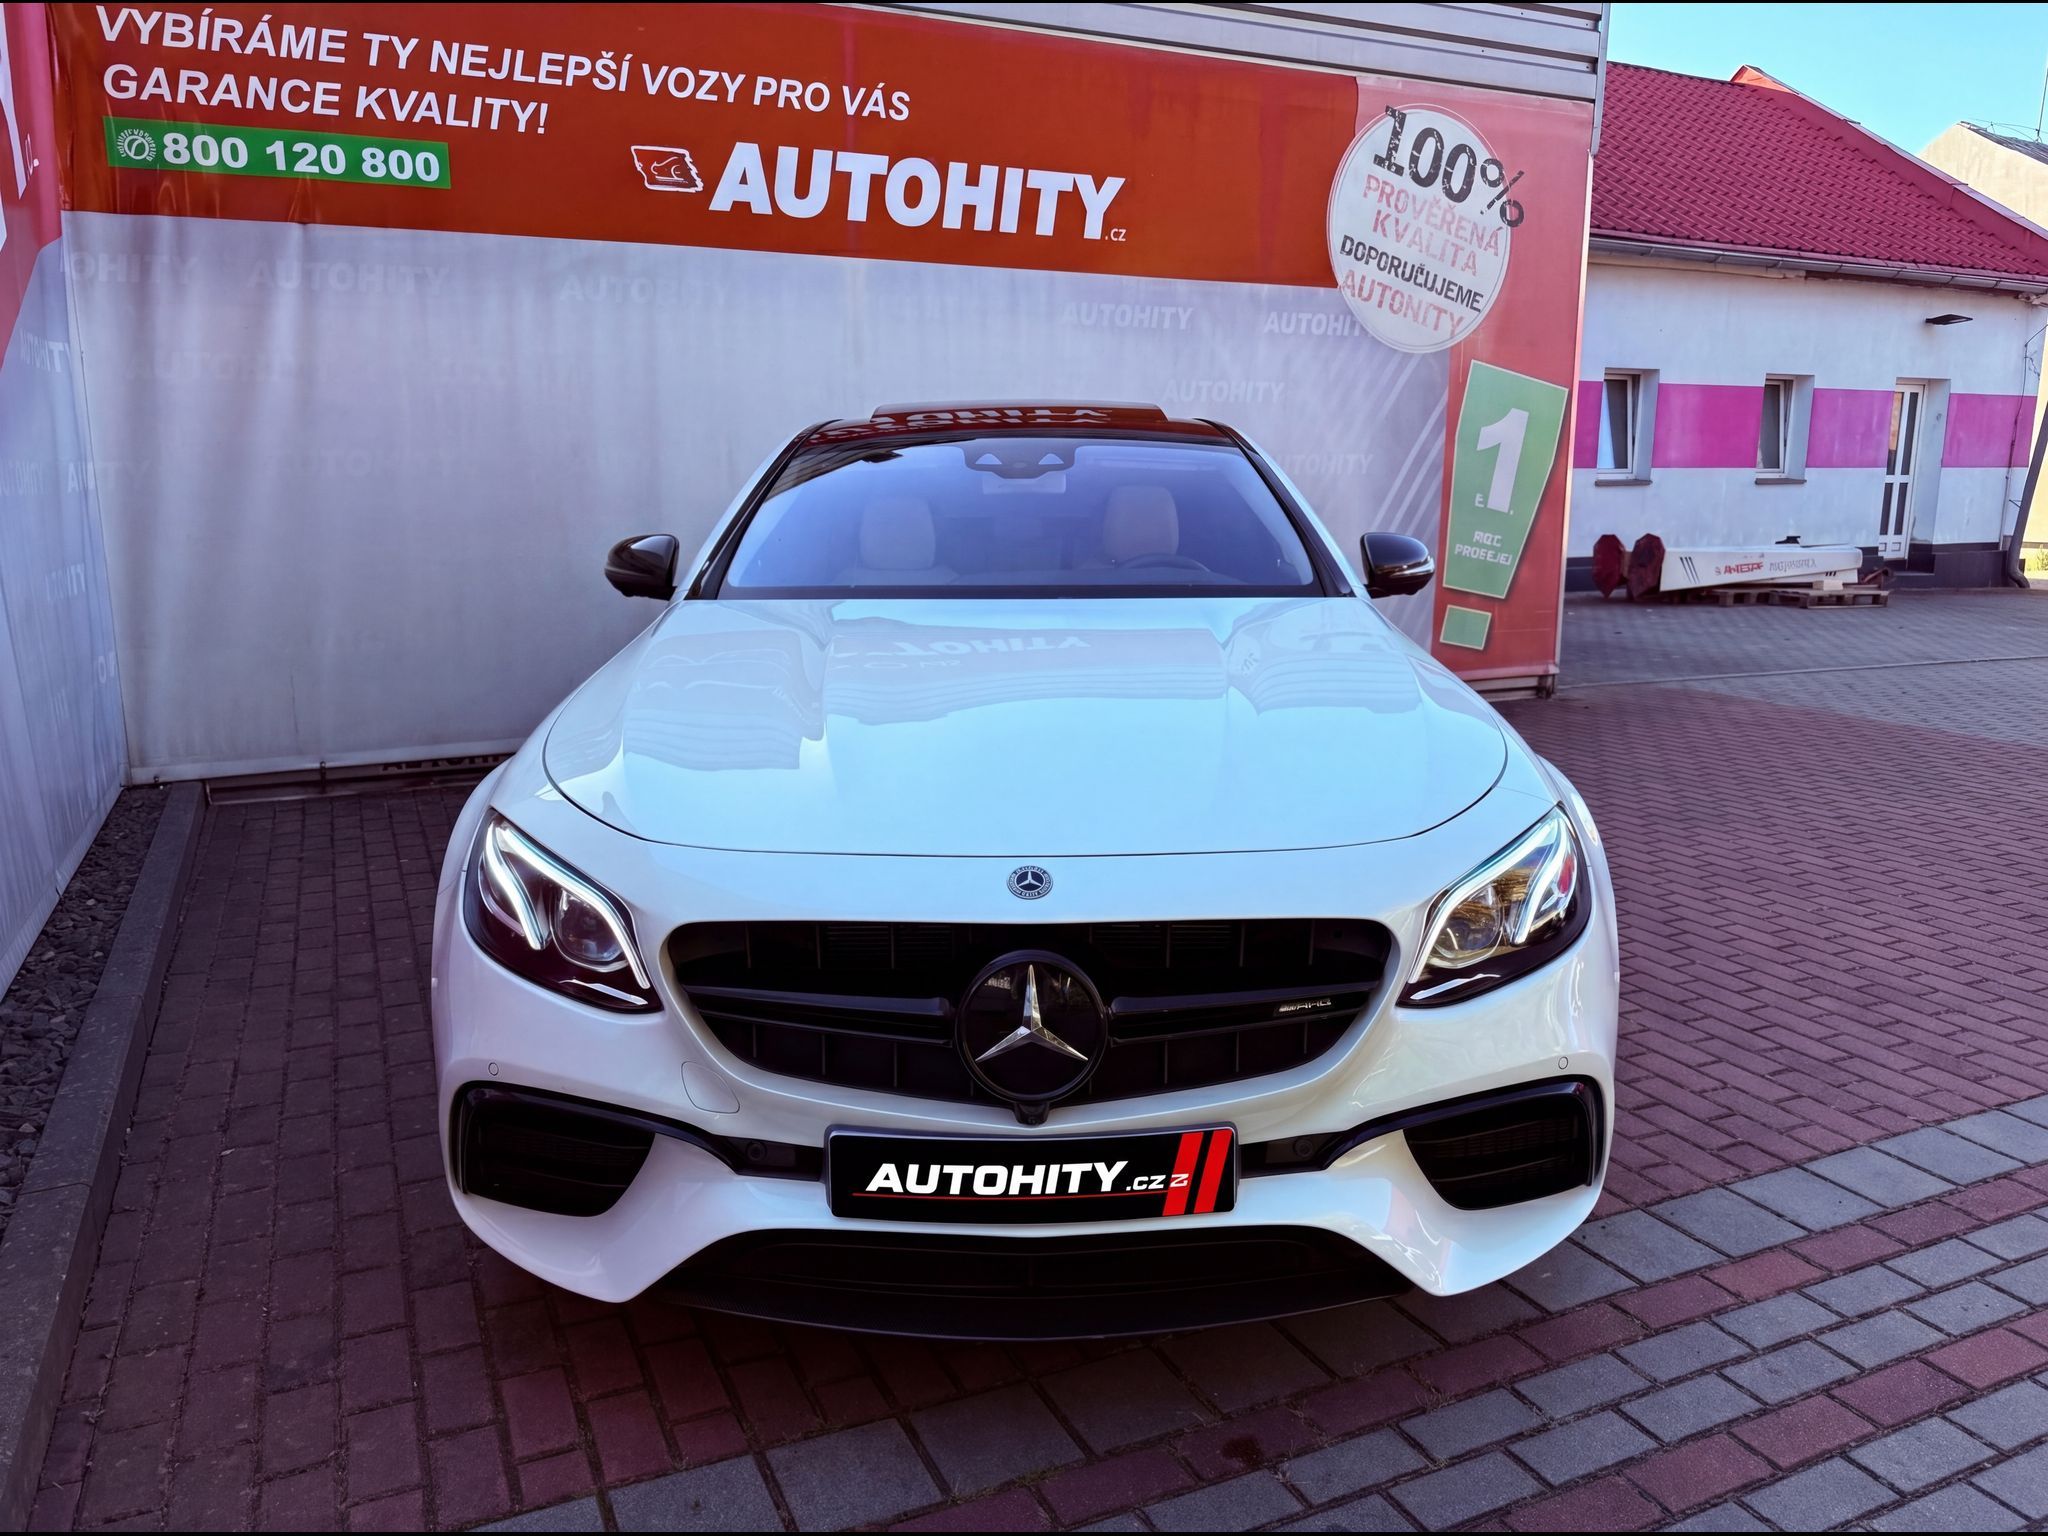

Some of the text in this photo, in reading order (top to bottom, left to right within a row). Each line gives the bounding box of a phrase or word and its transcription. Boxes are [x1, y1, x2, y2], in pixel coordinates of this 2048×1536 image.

[96, 5, 911, 121] VYBÍRÁME TY NEJLEPŠÍ VOZY PRO VÁS
[103, 63, 548, 134] GARANCE KVALITY!
[163, 131, 248, 168] 800
[265, 140, 347, 175] 120
[361, 147, 440, 182] 800
[1373, 105, 1525, 228] 100%
[1340, 234, 1484, 313] DOPORUČUJEME
[1372, 209, 1478, 277] KVALITA
[1060, 302, 1194, 331] AUTOHITY
